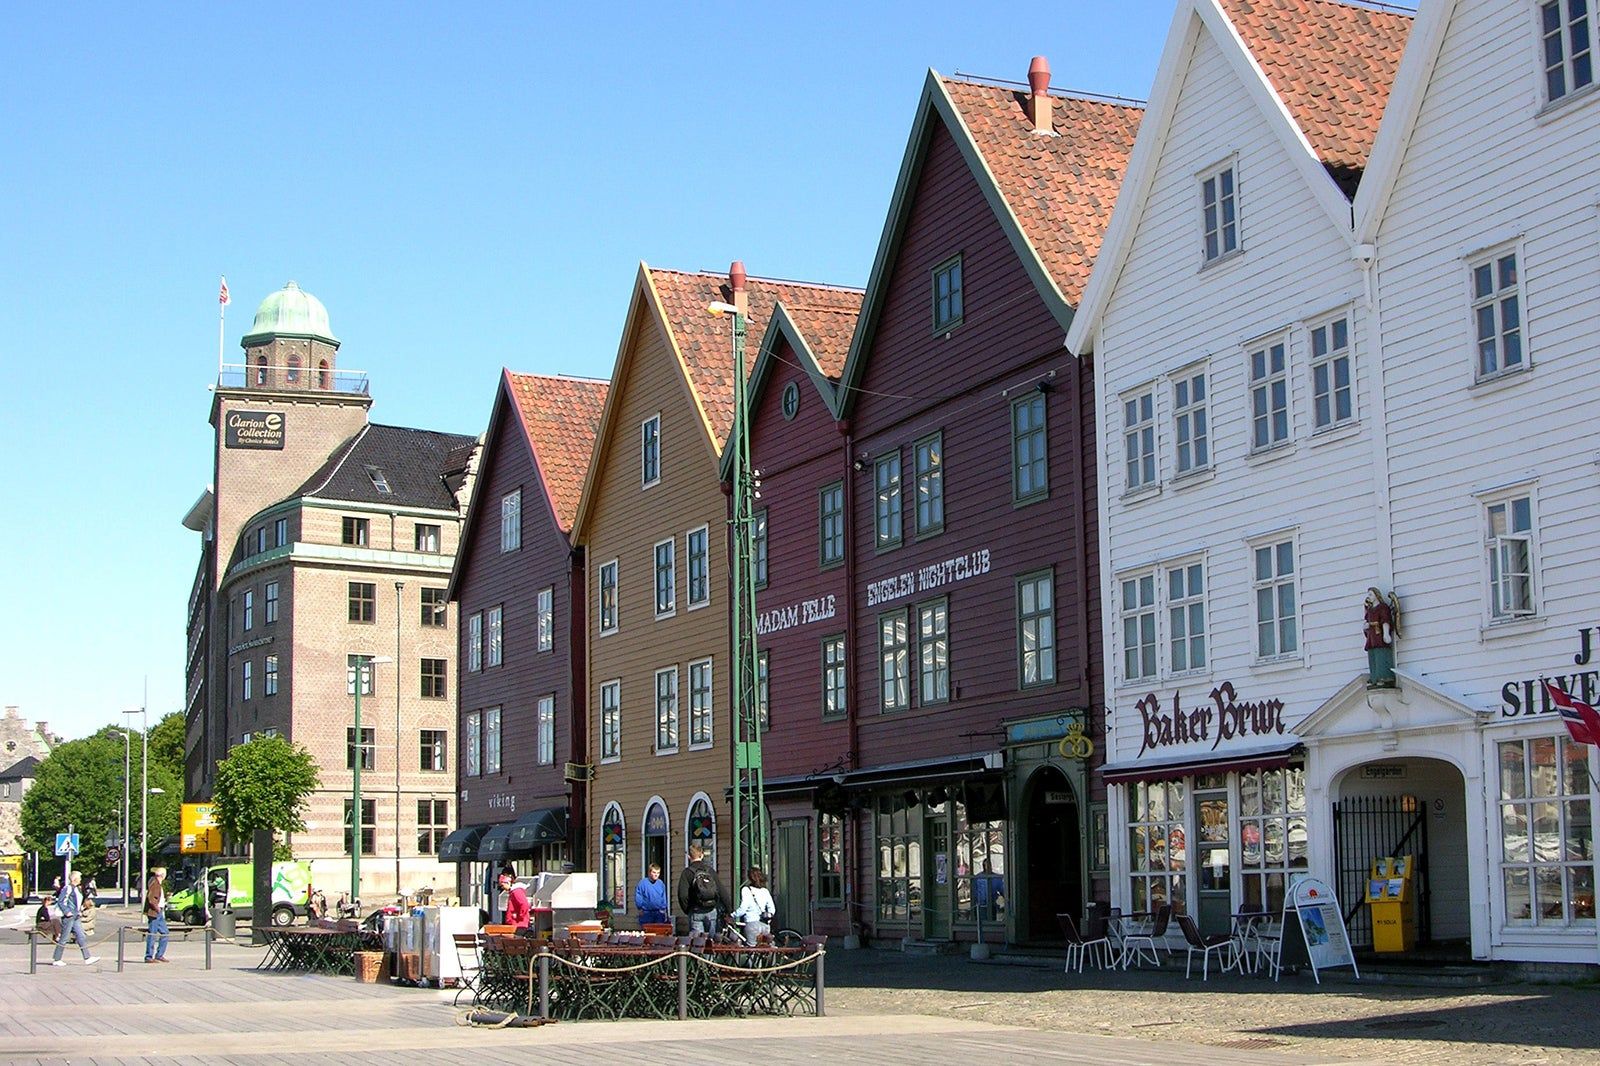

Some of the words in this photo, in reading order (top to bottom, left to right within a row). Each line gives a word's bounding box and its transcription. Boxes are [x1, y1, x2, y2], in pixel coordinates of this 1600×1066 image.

[230, 414, 265, 428] Clarion
[237, 428, 282, 438] Collection
[867, 572, 914, 607] ENGELEN
[918, 549, 991, 592] NIGHTCLUB
[755, 603, 798, 635] MADAM
[801, 594, 836, 625] FELLE
[1135, 690, 1213, 759] Baker
[1209, 681, 1286, 751] Brun
[488, 794, 515, 812] viking
